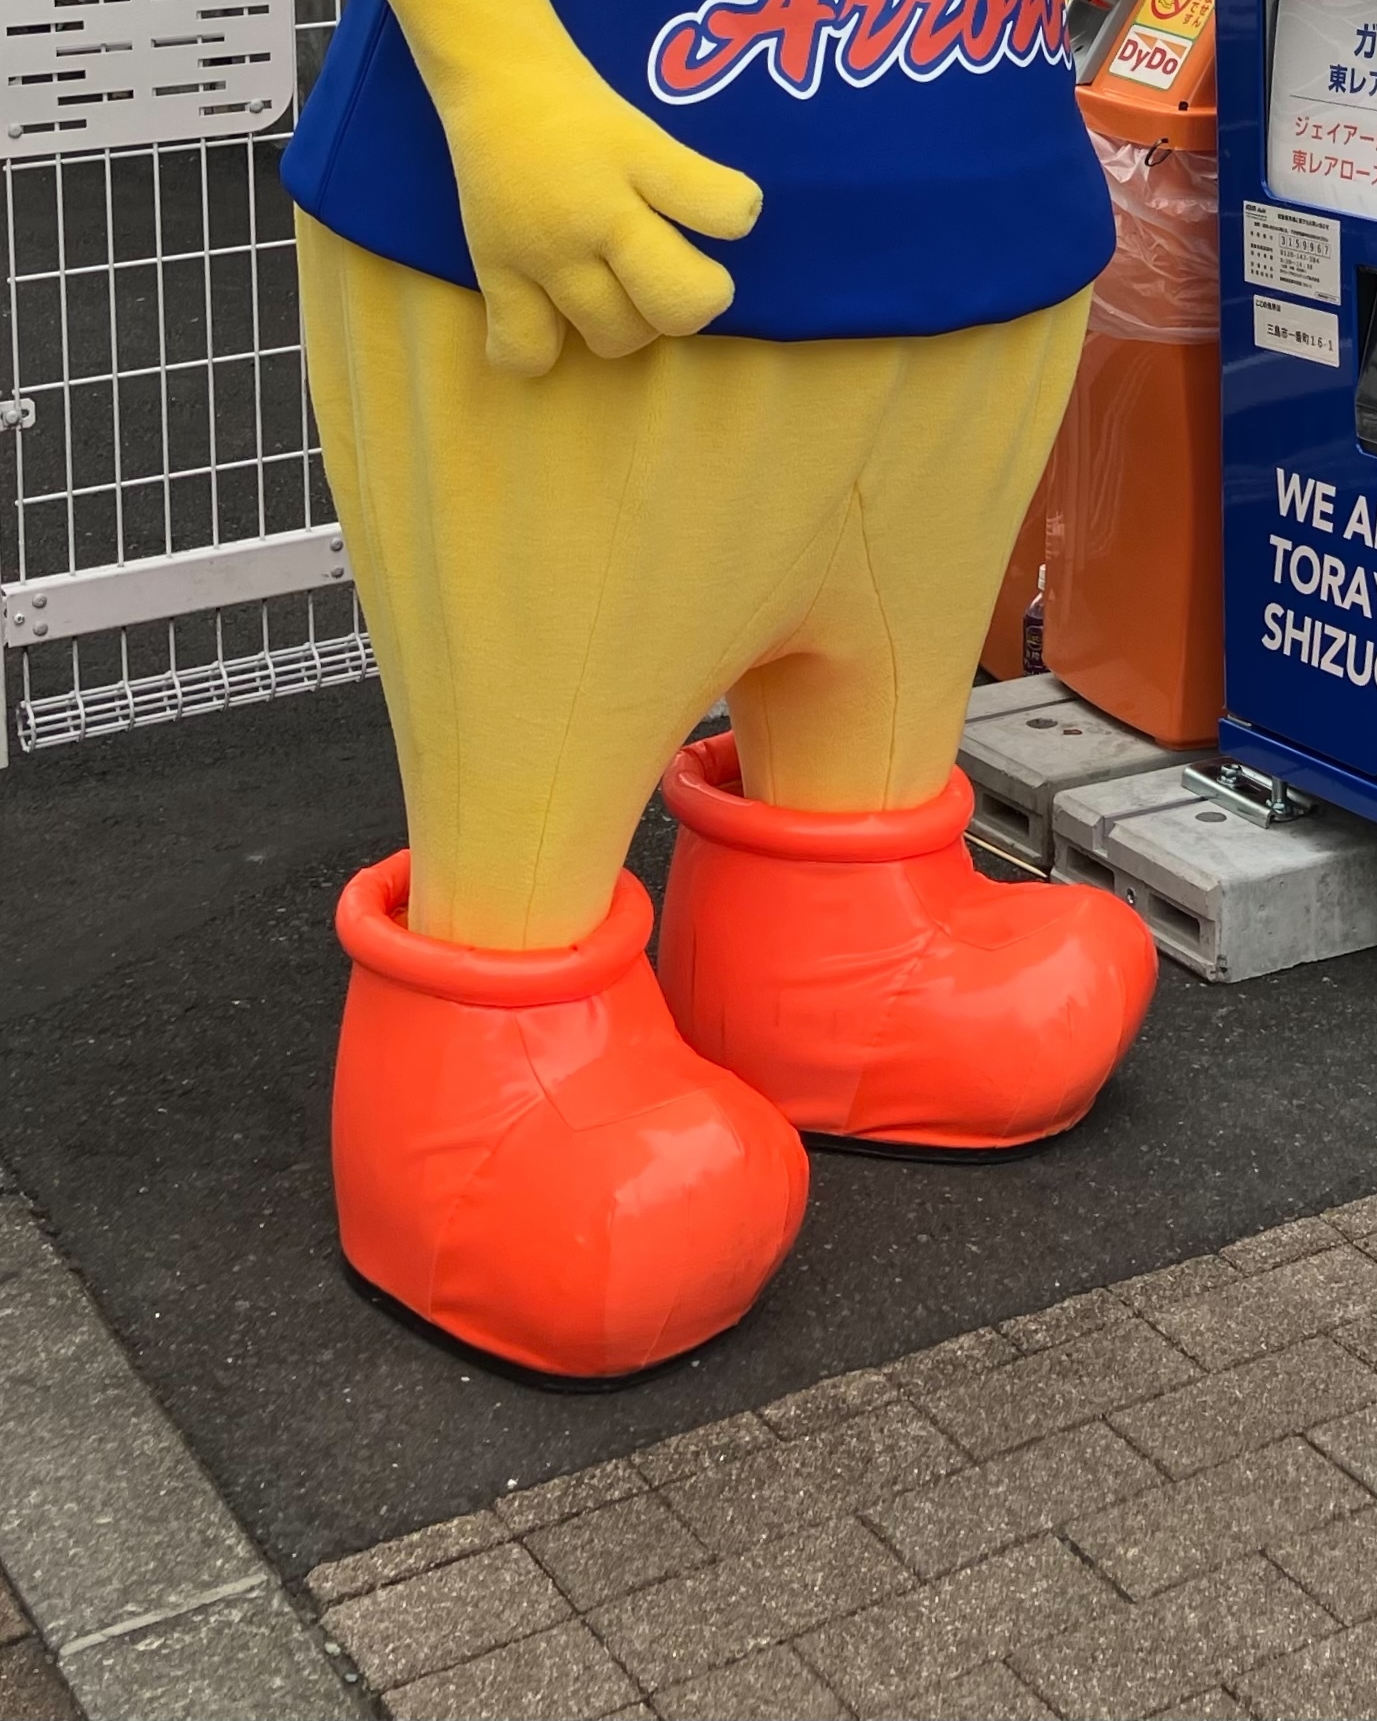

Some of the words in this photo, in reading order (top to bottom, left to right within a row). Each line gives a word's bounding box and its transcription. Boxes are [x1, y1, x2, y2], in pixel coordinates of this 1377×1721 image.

[1118, 39, 1178, 76] DyDo
[1281, 235, 1328, 255] 3159967
[1276, 467, 1336, 533] WE
